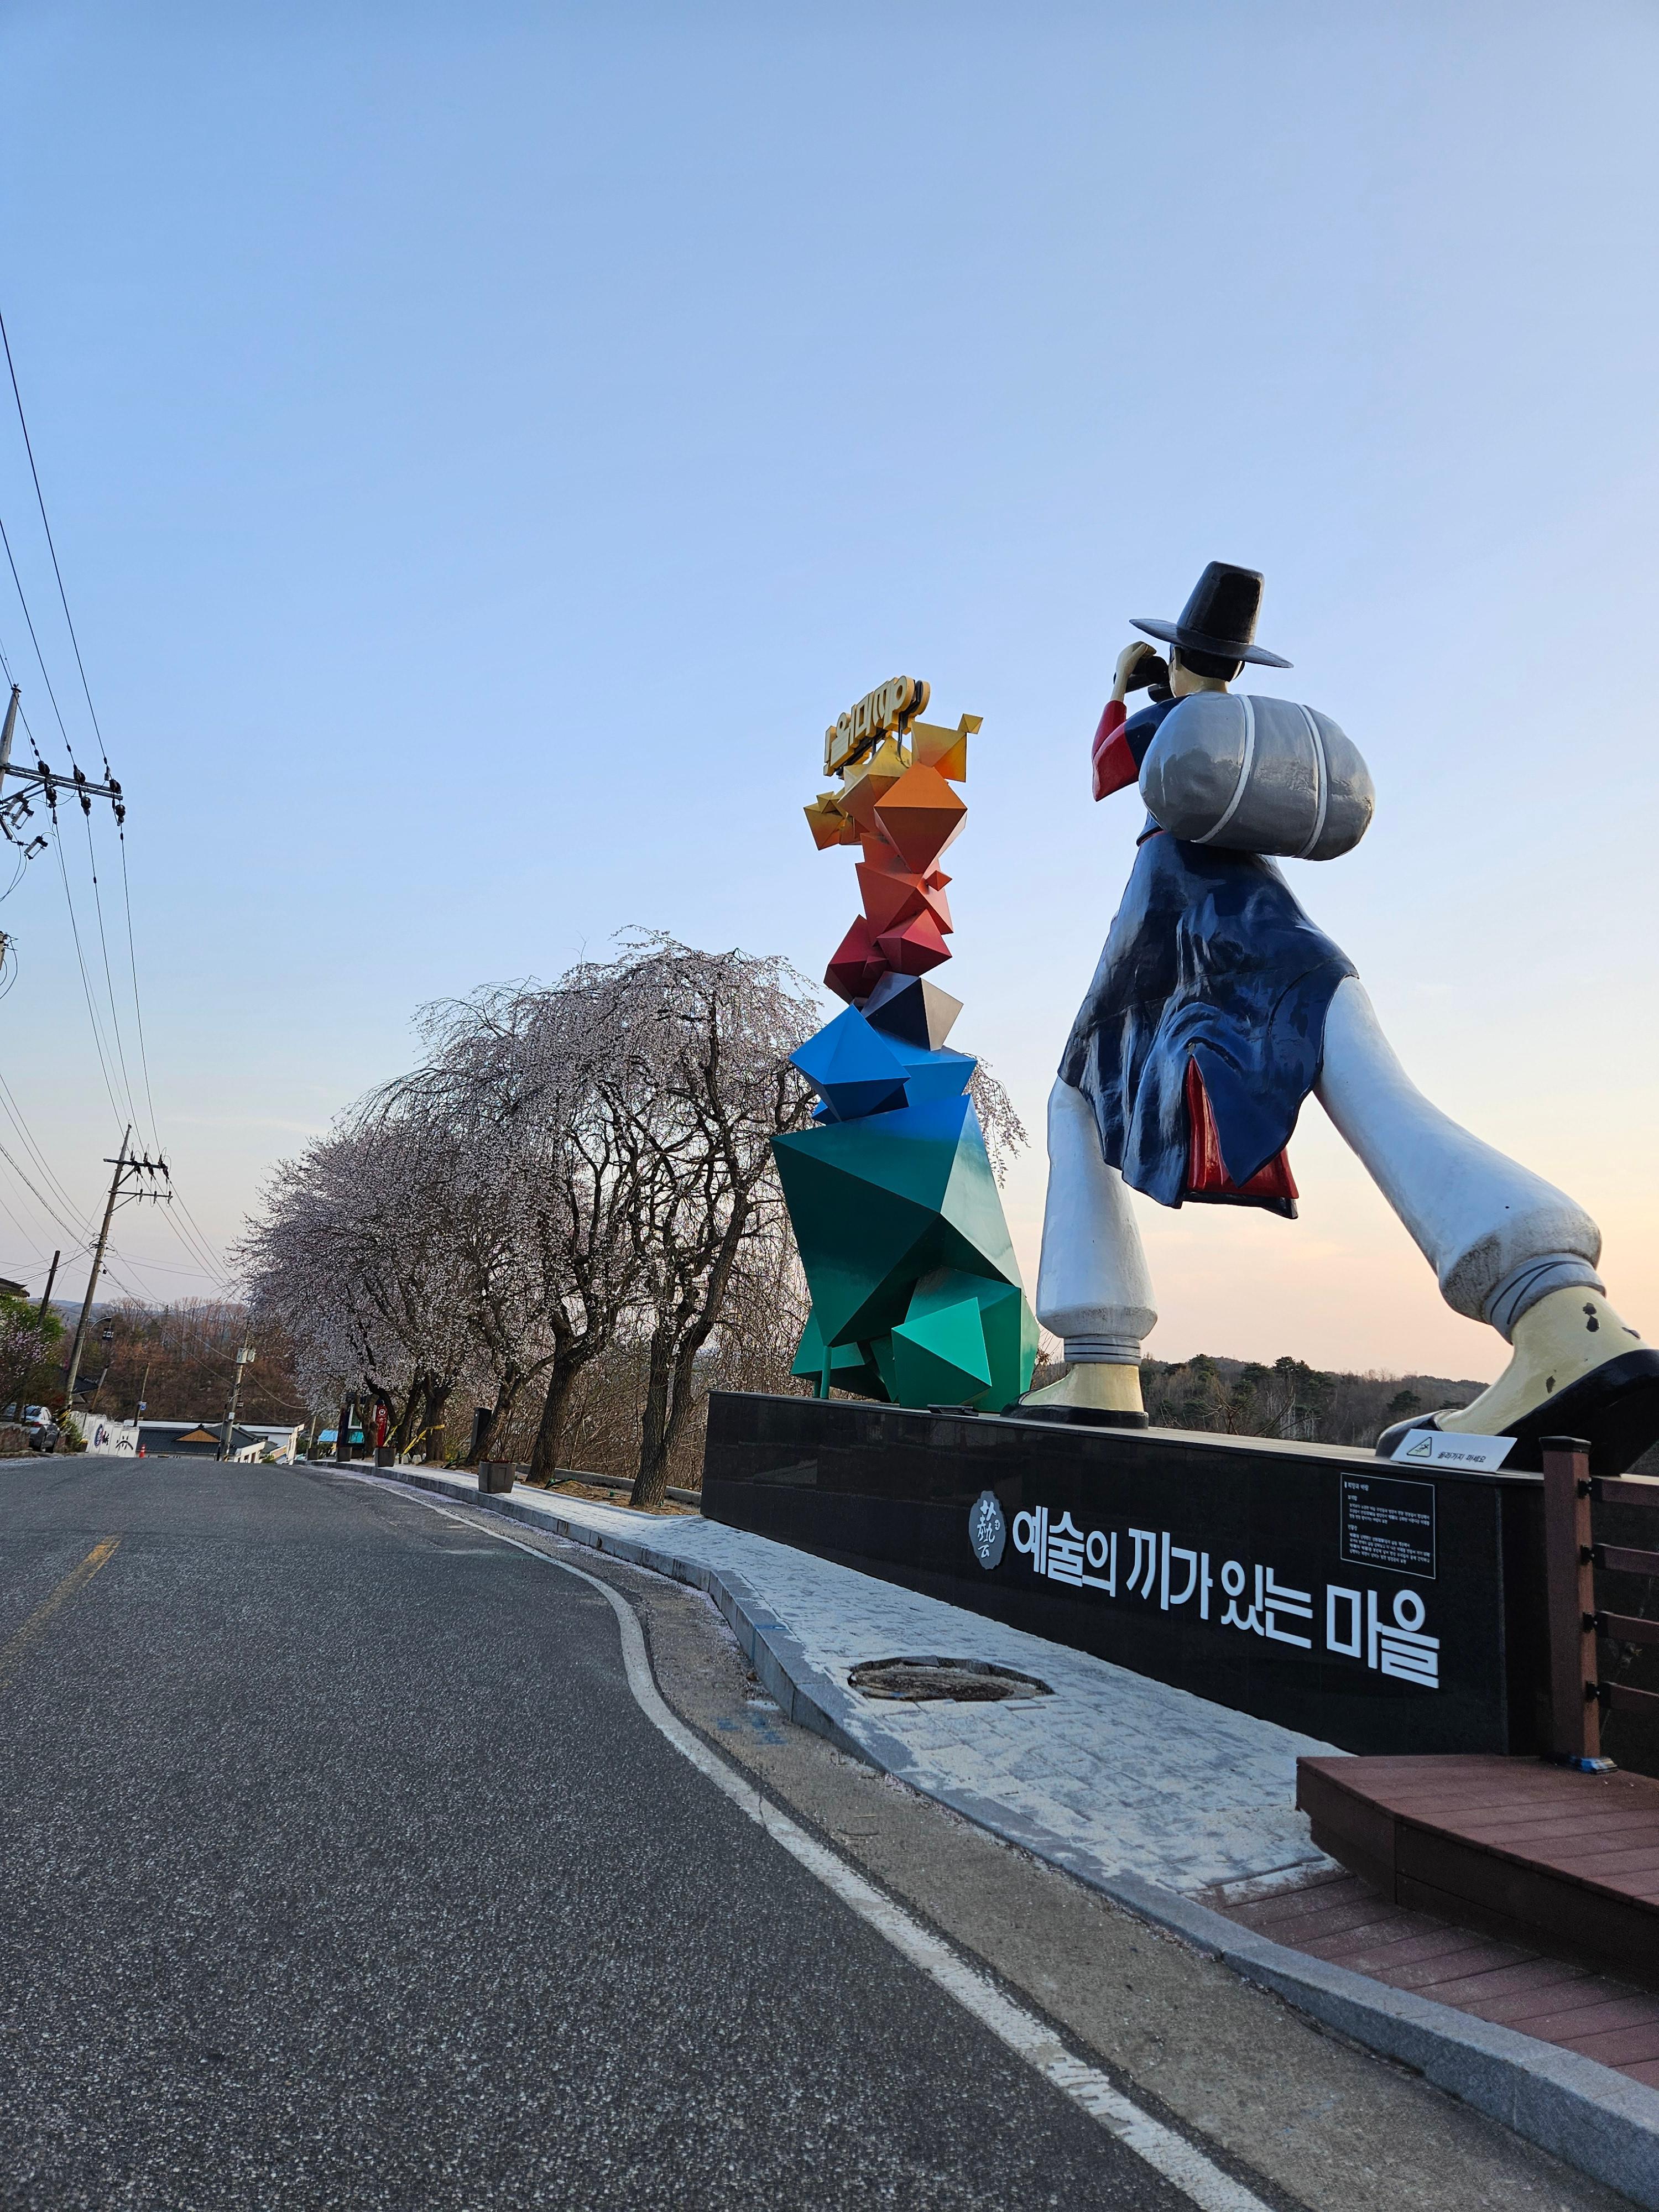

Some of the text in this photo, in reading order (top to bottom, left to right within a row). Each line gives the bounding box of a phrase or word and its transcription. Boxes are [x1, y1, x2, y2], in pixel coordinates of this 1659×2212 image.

[1013, 1505, 1439, 1689] 예술의 끼가 있는 마을
